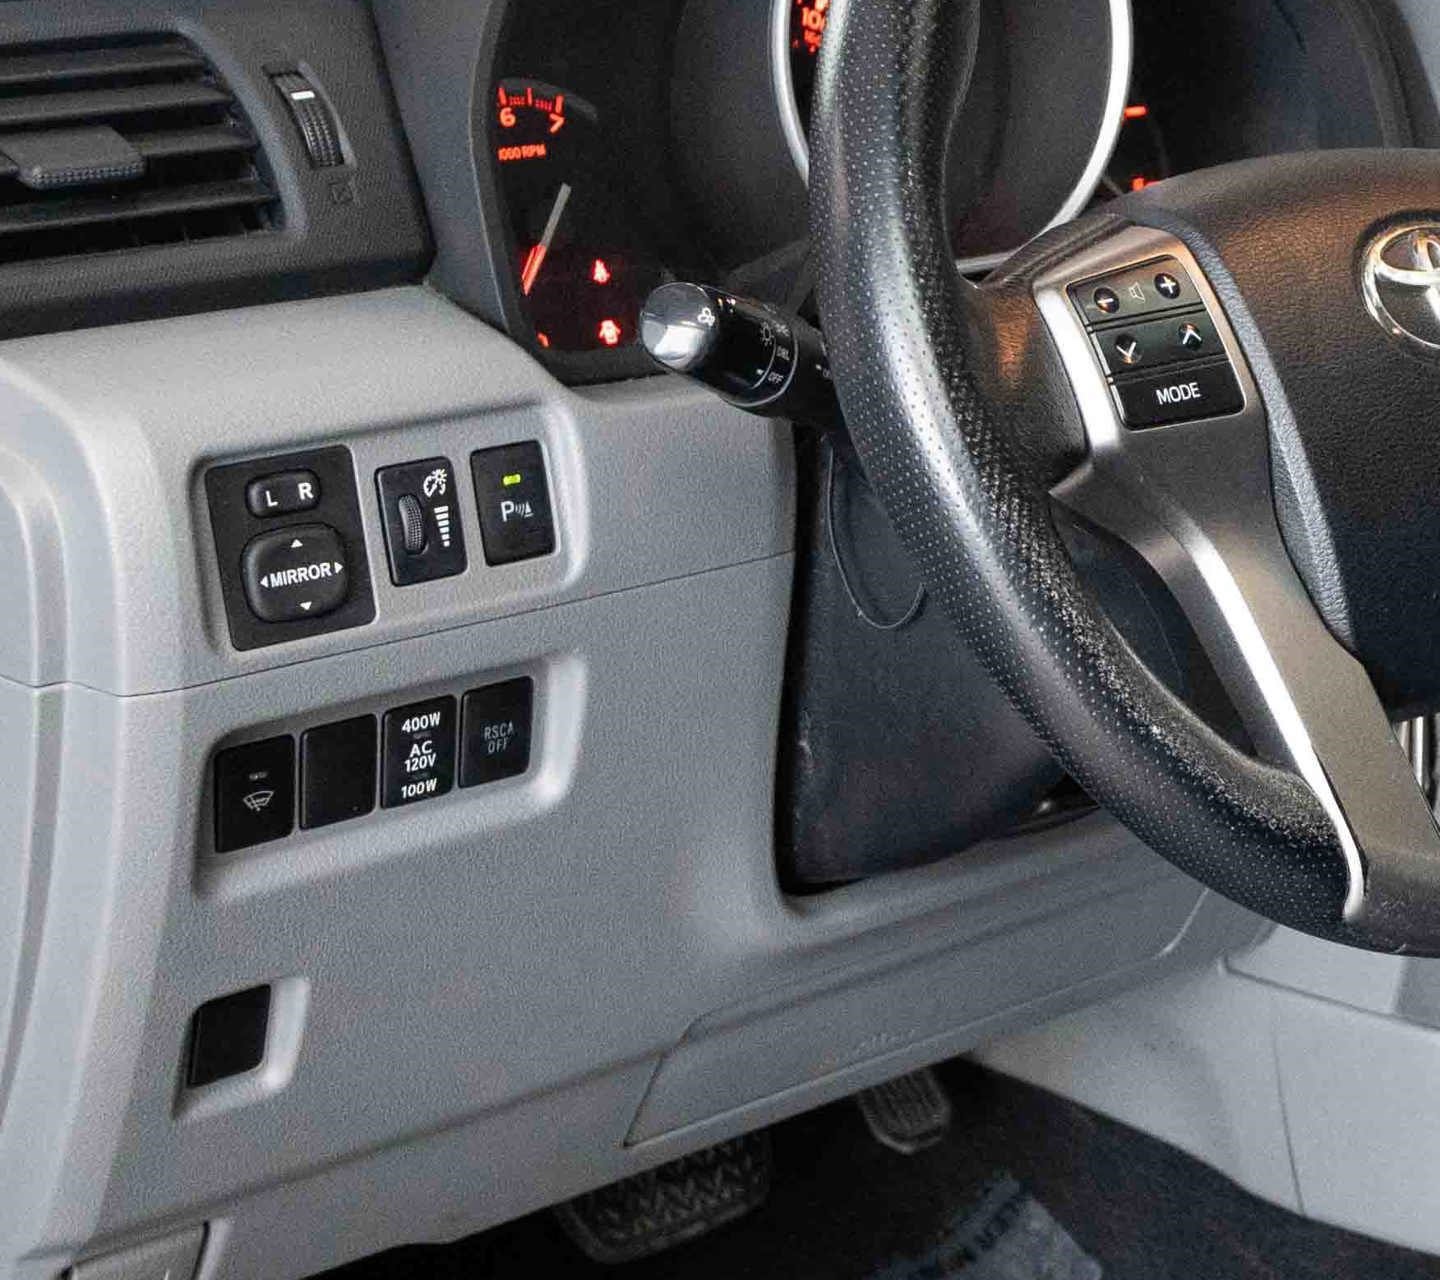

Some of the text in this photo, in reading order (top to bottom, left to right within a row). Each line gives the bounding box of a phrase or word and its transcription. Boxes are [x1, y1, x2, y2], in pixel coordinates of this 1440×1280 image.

[500, 106, 565, 134] 6 7
[1156, 382, 1202, 405] MODE
[265, 482, 314, 508] L R
[269, 562, 333, 589] MIRROR
[401, 711, 441, 734] 400W
[483, 721, 515, 742] RSCA
[409, 740, 433, 759] AC
[487, 737, 510, 755] OFF
[404, 753, 437, 774] 120V
[400, 778, 438, 800] 100W
